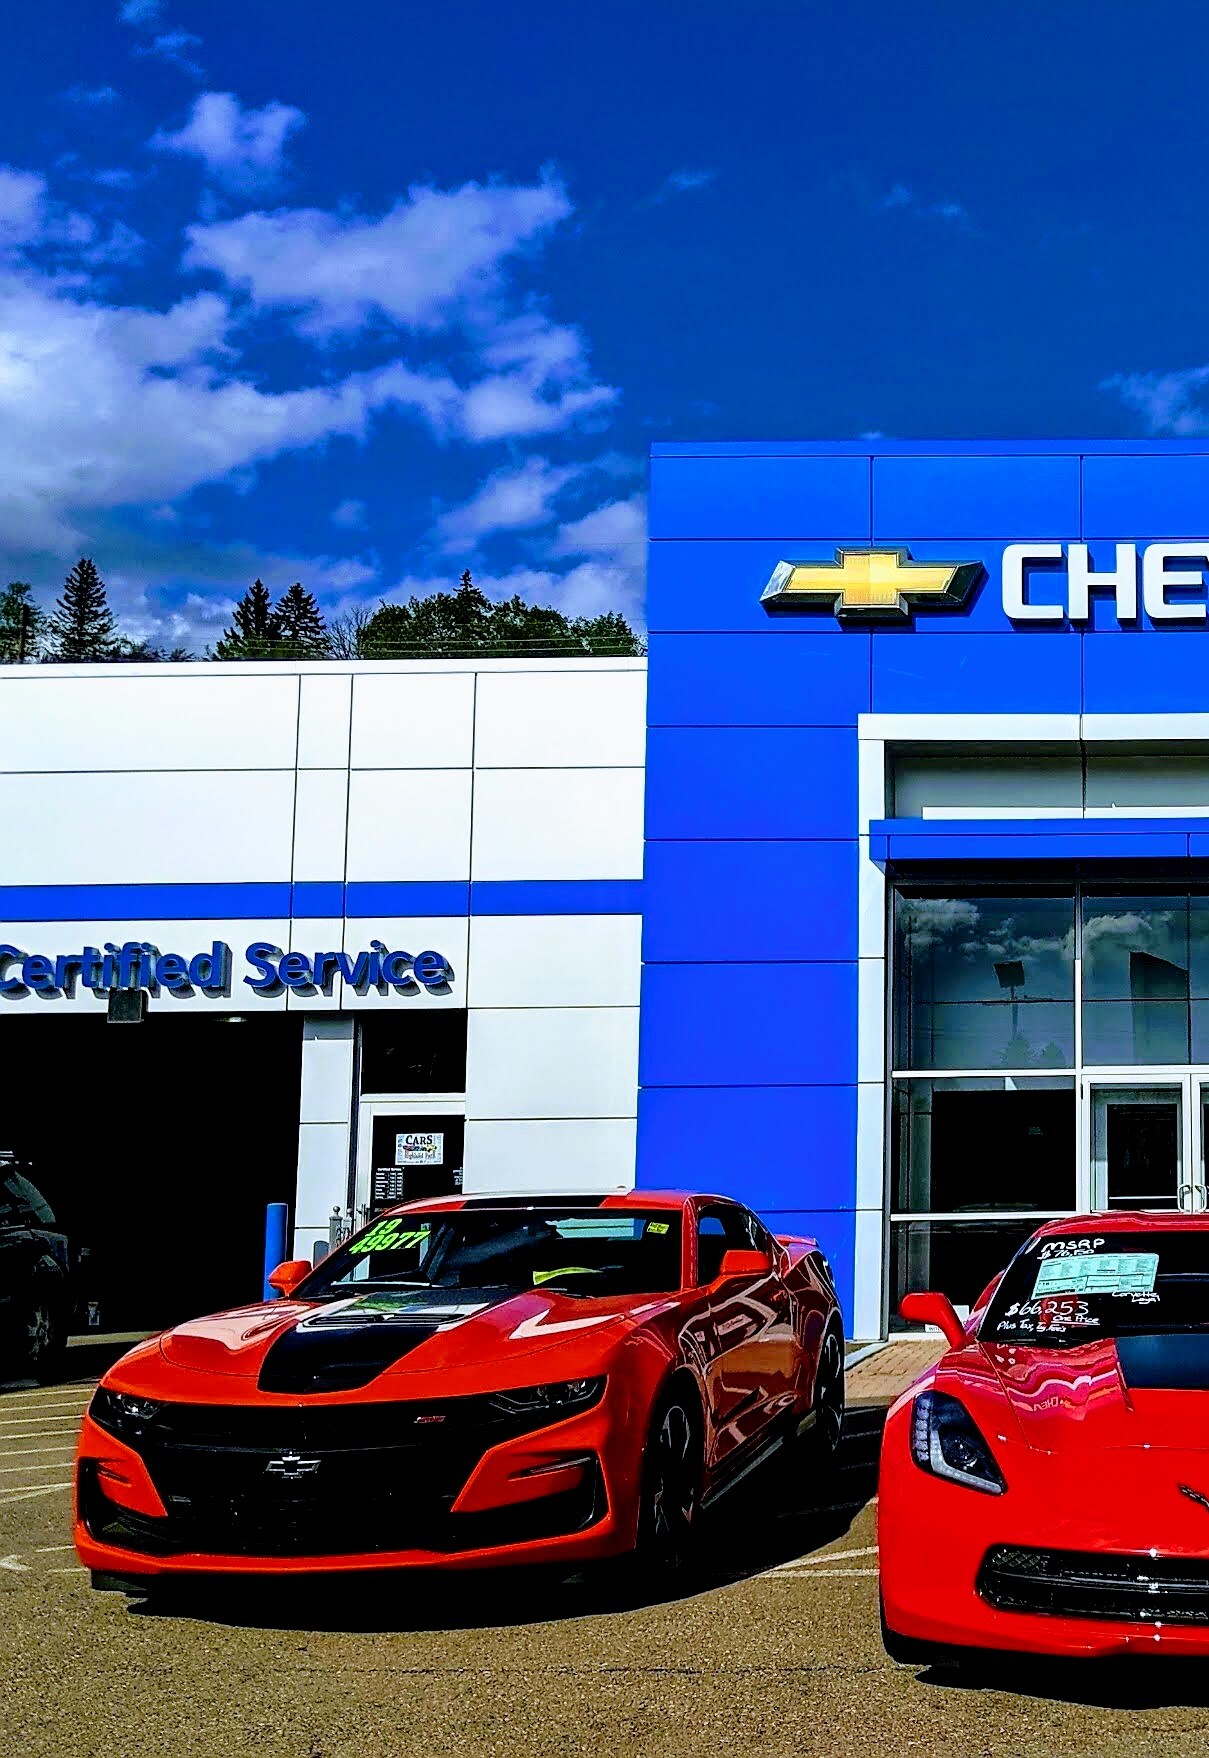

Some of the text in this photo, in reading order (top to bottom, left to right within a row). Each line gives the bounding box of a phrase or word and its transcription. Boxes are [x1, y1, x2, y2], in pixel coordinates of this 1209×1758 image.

[0, 940, 449, 990] Certified Service
[405, 1134, 433, 1146] CARS
[365, 1219, 402, 1237] 19
[349, 1231, 431, 1254] 49977
[1041, 1238, 1105, 1253] MSRP
